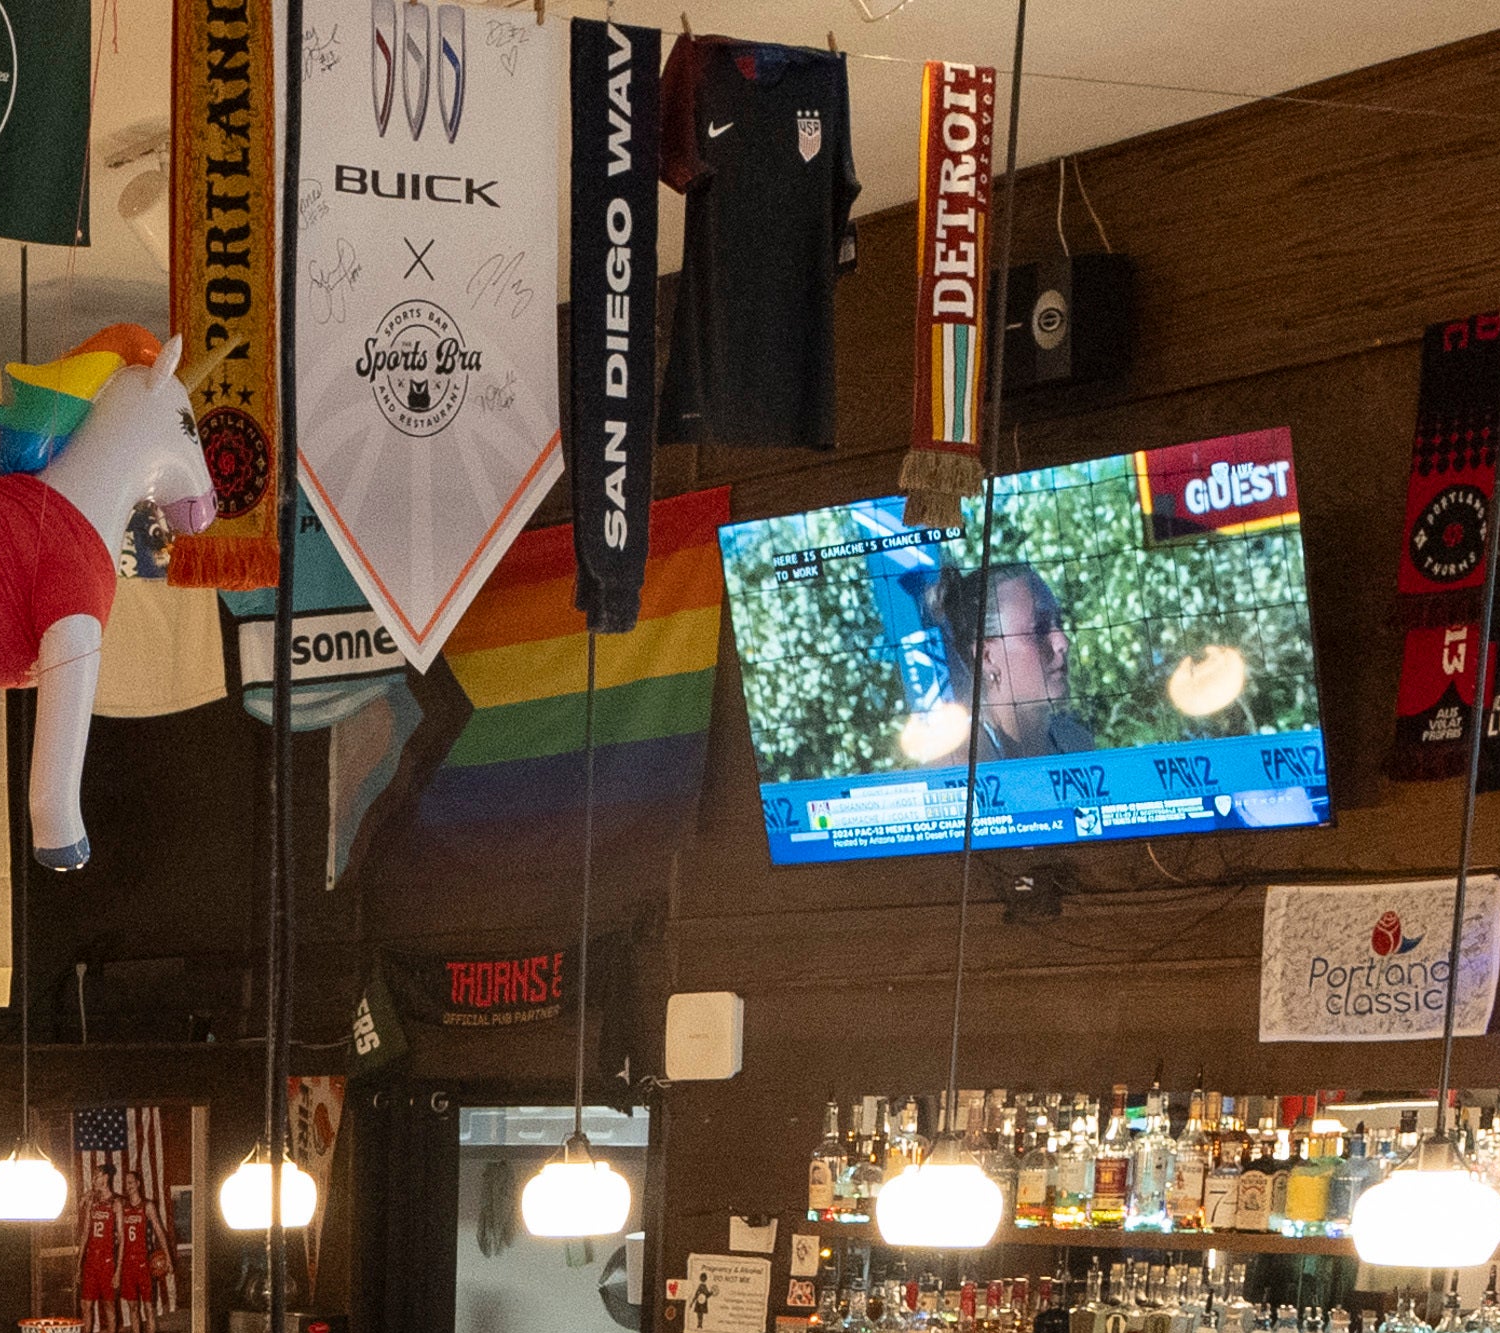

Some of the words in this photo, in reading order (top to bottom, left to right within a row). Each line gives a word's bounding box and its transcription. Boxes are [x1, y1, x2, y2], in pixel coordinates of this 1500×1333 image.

[335, 164, 501, 209] BUICK
[932, 65, 977, 318] DETROIT
[606, 198, 634, 400] DIEGO
[384, 308, 422, 337] SPORTS
[428, 311, 448, 333] BAR
[355, 337, 428, 384] Sports
[435, 337, 483, 376] Bra
[379, 385, 396, 413] AND
[399, 384, 461, 428] RESTAURANT
[604, 420, 632, 552] SAN
[1184, 460, 1290, 515] GUEST
[821, 540, 878, 559] GAMACHE'S
[882, 533, 922, 548] CHANCE
[926, 529, 942, 541] TO
[946, 526, 961, 539] GO
[775, 571, 789, 582] TO
[793, 567, 819, 580] WORK
[914, 822, 938, 834] GOLF
[445, 955, 548, 1008] THORNS
[1308, 951, 1457, 991] Portland
[442, 1012, 490, 1026] OFFICIAL
[1326, 986, 1445, 1016] classic
[128, 1225, 137, 1242] 6
[701, 1263, 733, 1274] Pregnancy
